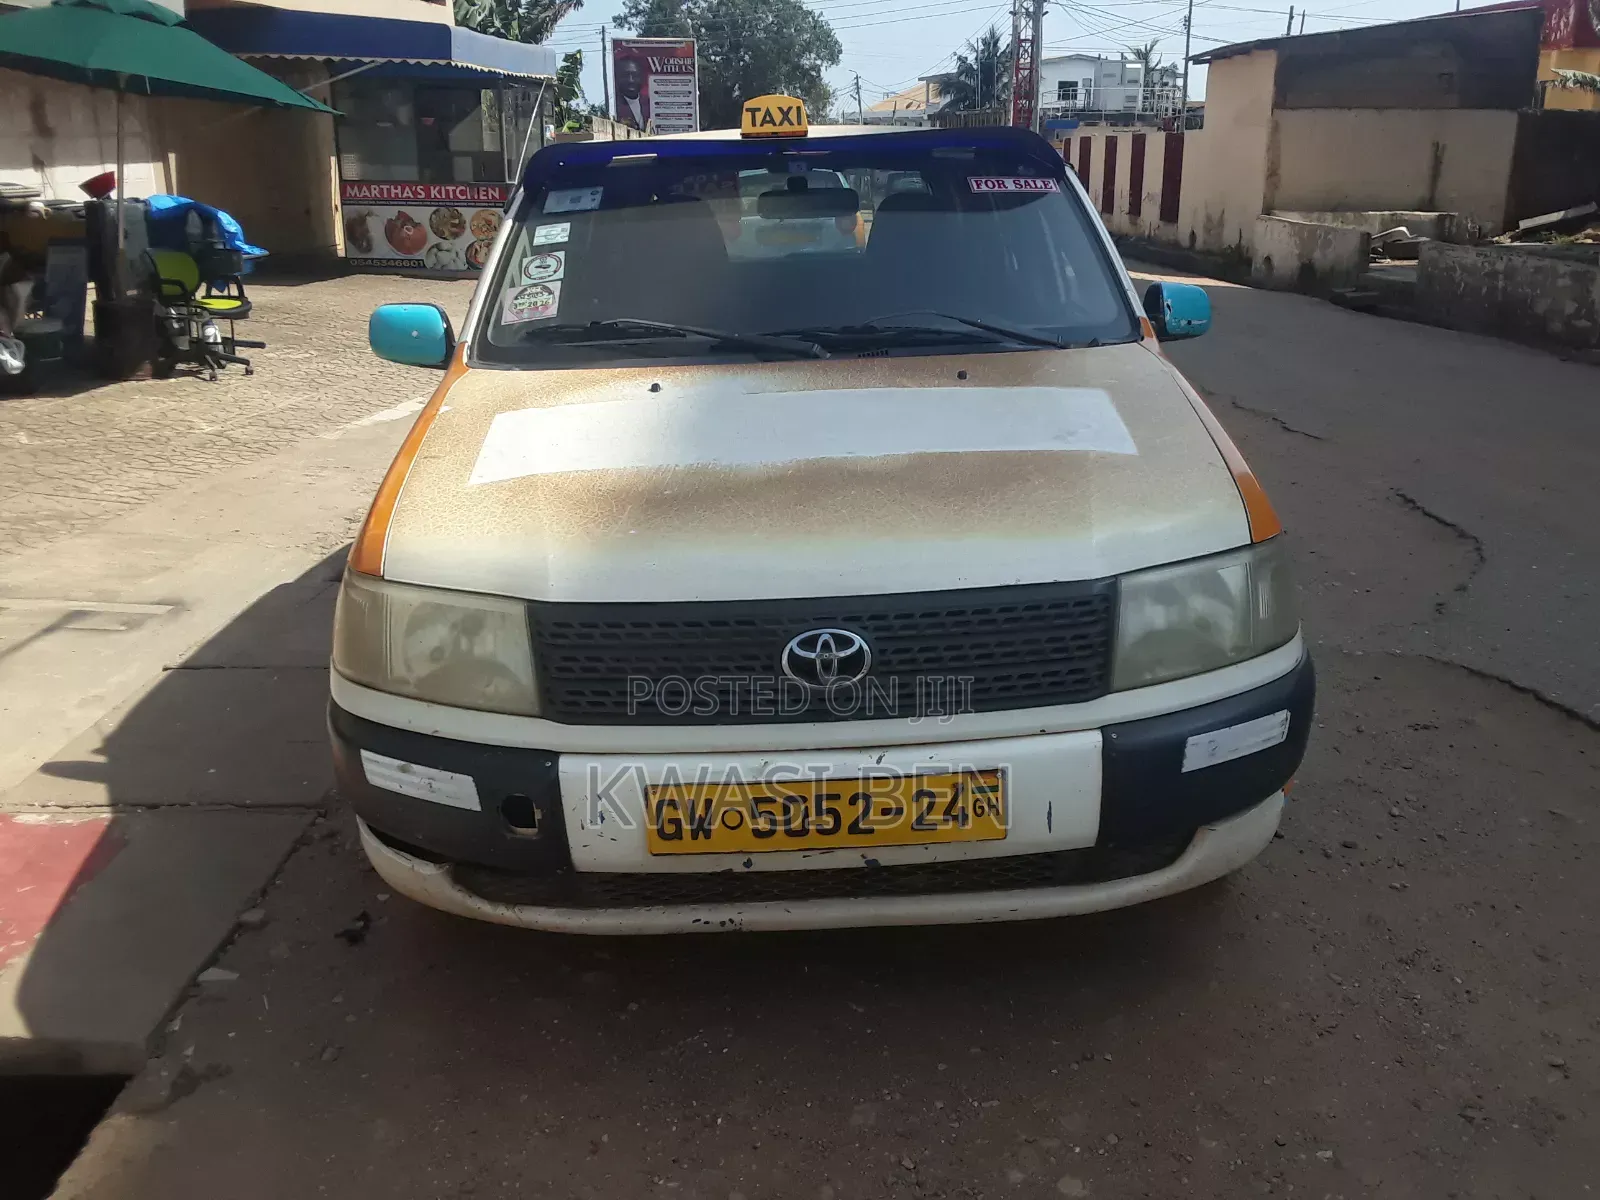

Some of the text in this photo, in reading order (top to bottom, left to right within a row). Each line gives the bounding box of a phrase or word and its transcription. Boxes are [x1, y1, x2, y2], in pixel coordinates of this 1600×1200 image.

[745, 106, 802, 127] TAXI
[346, 185, 426, 199] MARTHA'S
[974, 179, 1053, 190] FOR SALE
[655, 797, 713, 841] GW
[973, 797, 999, 818] GH
